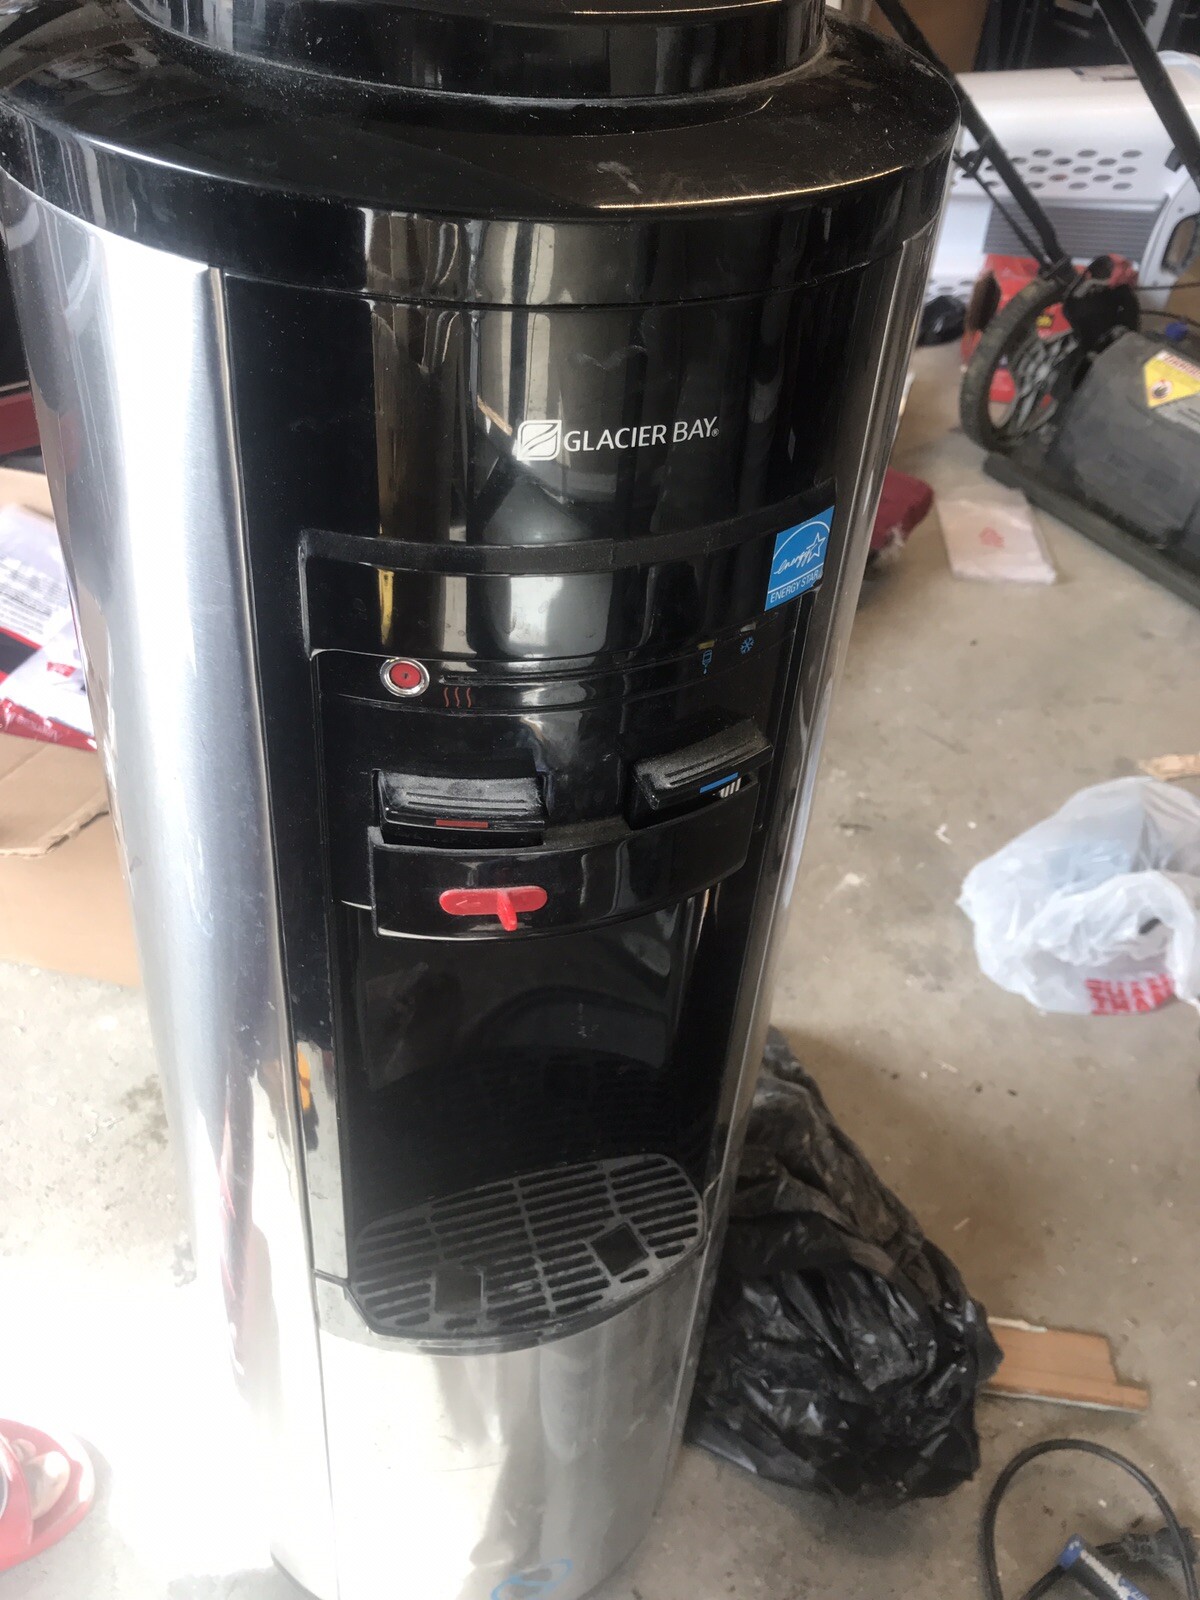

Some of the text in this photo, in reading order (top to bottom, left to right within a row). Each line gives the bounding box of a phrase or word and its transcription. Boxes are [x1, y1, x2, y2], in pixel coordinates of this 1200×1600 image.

[563, 425, 667, 452] GLACIER
[770, 569, 821, 603] ENERGY STAR
